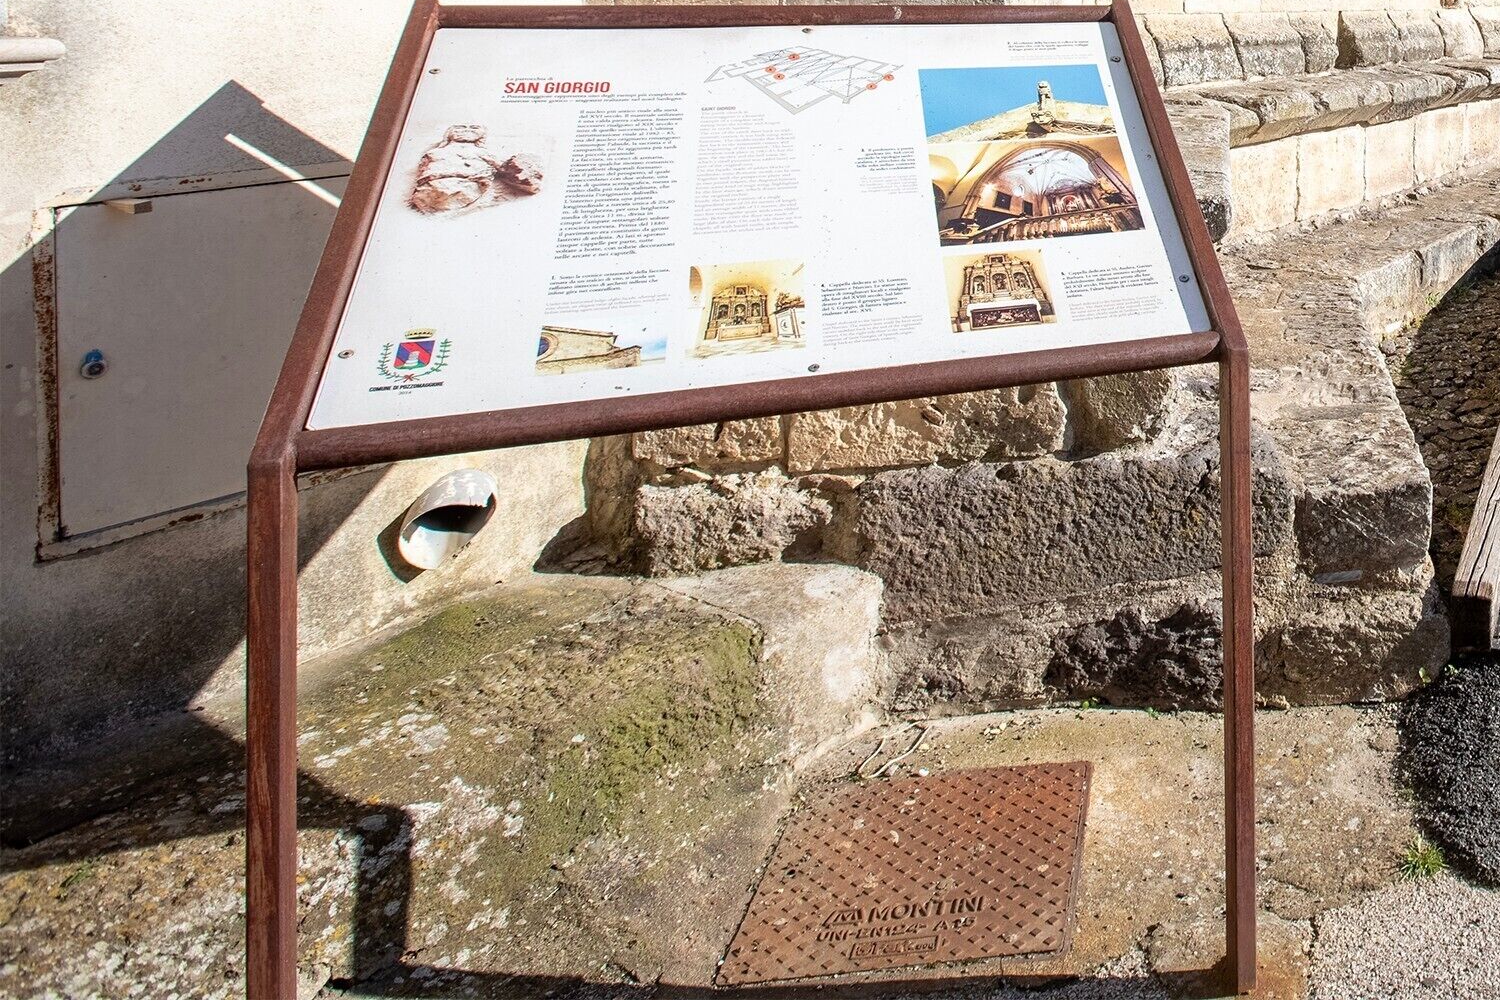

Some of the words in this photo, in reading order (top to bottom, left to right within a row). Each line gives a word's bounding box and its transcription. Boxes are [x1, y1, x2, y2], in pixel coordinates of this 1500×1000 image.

[504, 82, 539, 94] SAN
[544, 81, 611, 93] GIORGIO
[868, 896, 984, 925] MONTINI
